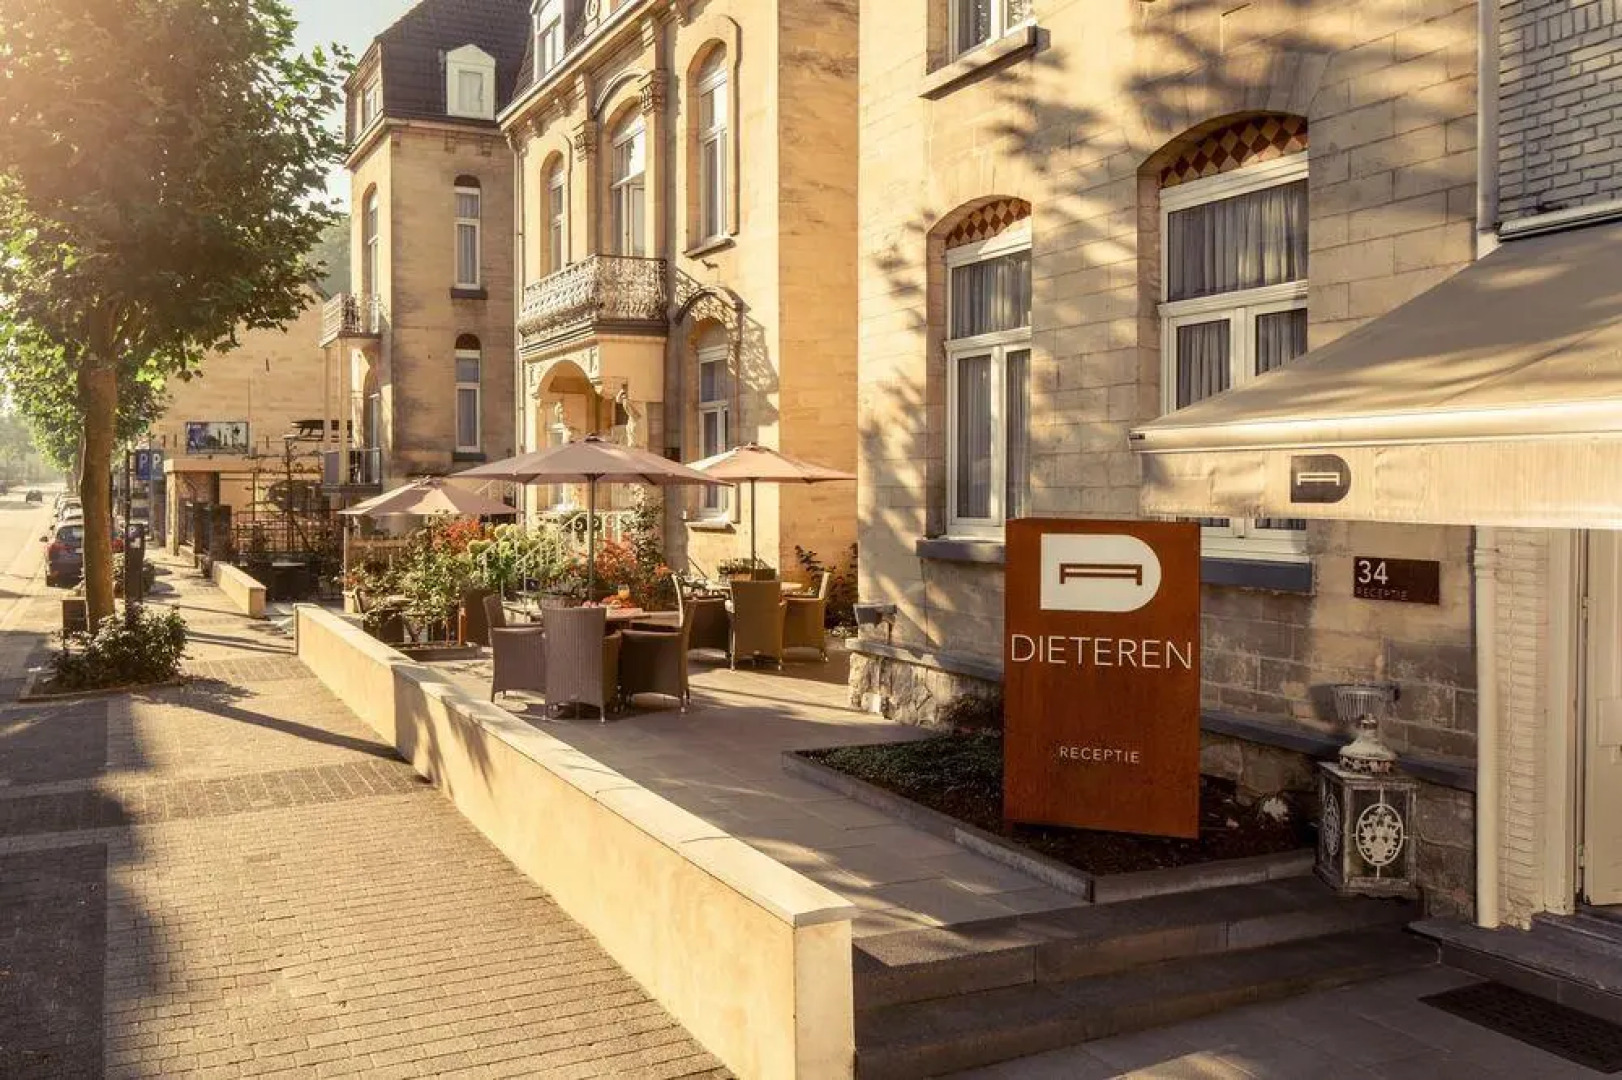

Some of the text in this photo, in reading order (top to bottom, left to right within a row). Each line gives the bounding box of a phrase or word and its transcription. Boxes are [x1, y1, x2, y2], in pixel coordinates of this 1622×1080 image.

[152, 453, 161, 470] P
[1358, 560, 1389, 585] 34
[1011, 634, 1192, 670] DIETEREN
[1059, 745, 1141, 764] RECEPTIE
